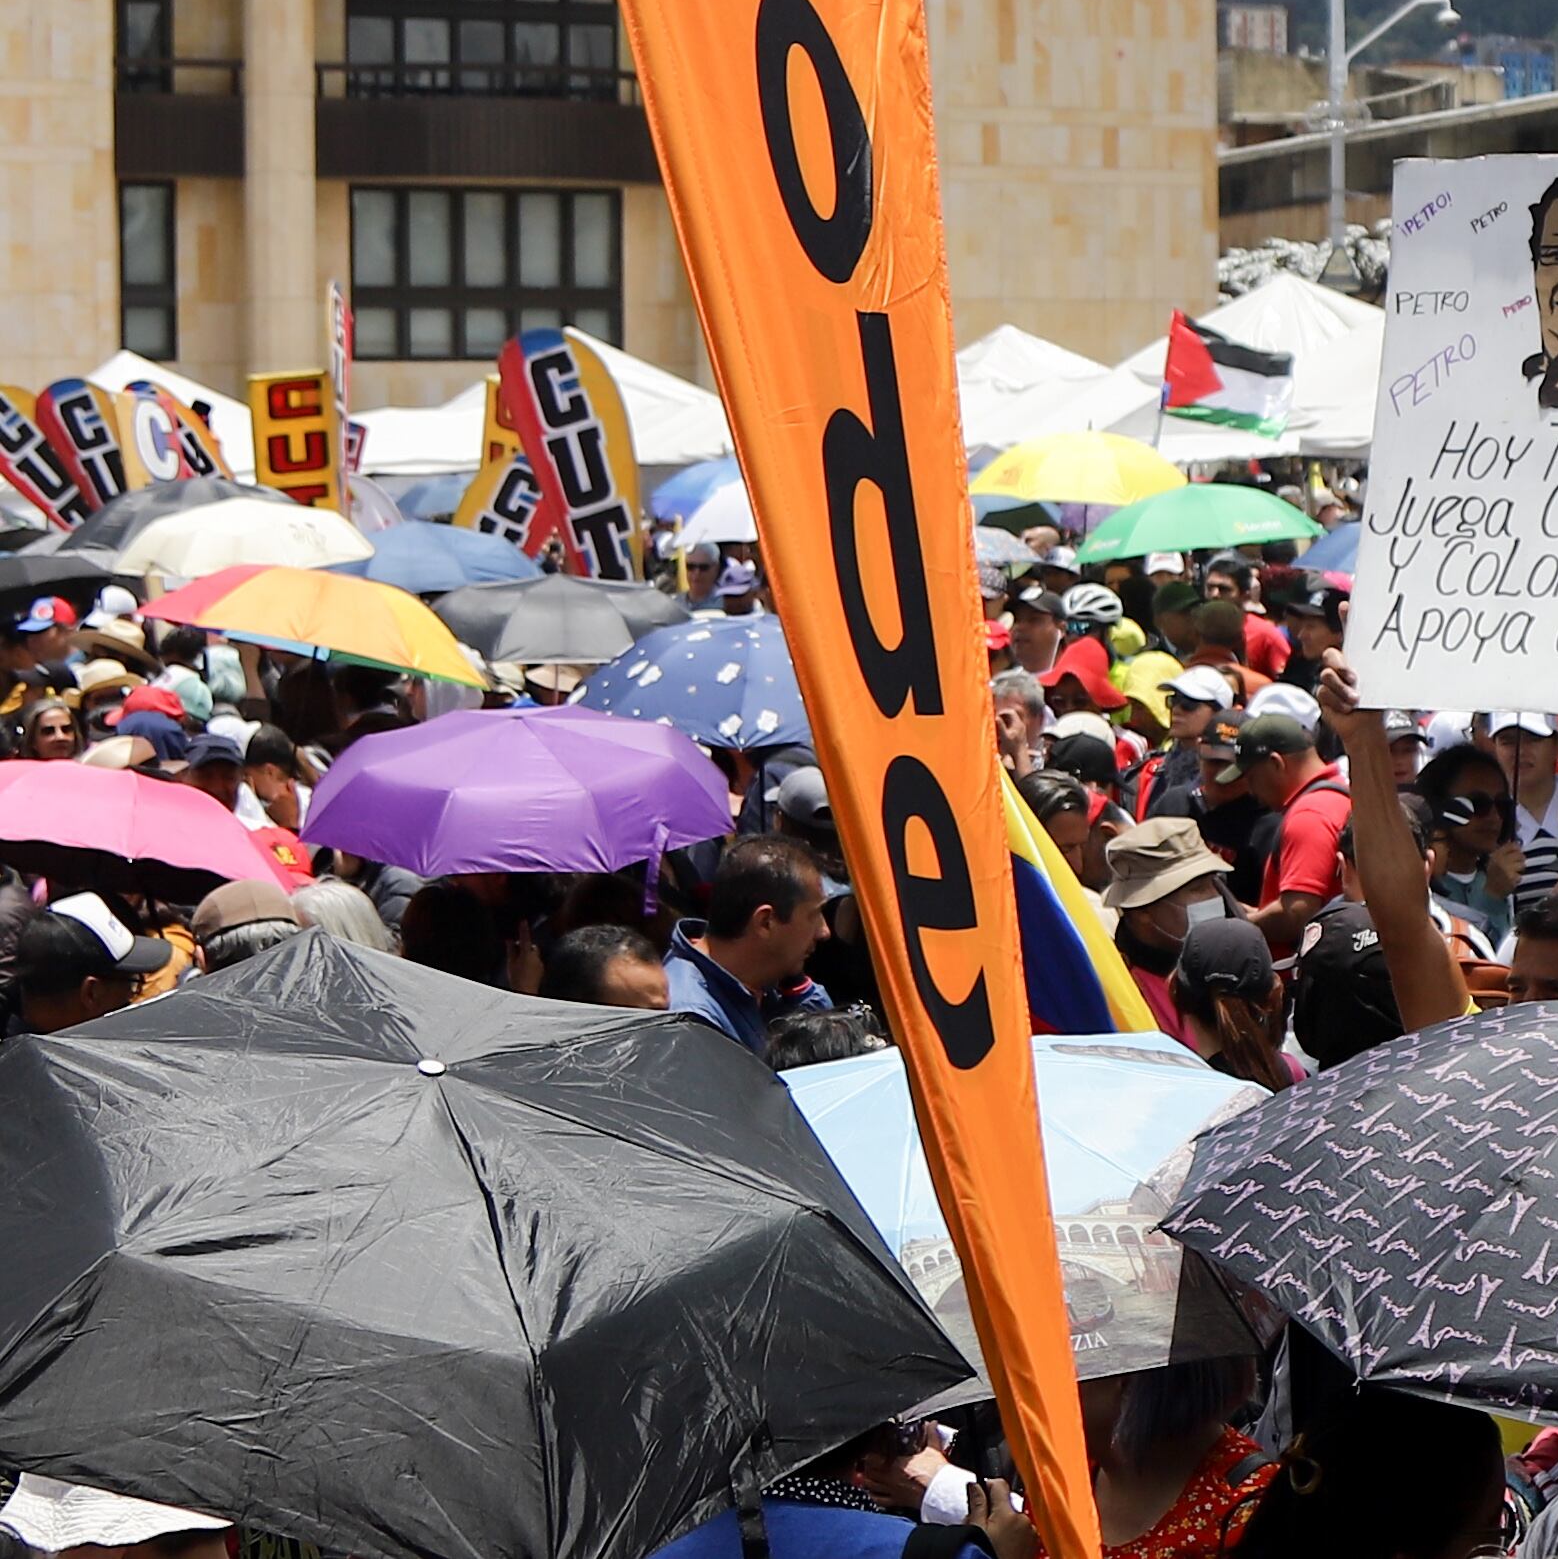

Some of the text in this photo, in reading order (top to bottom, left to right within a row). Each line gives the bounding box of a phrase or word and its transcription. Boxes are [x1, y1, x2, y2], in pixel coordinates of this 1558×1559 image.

[1396, 191, 1453, 239] ¡PETRO!
[1470, 200, 1509, 235] PETRO
[1396, 290, 1469, 315] PETRO
[1388, 333, 1477, 417] PETRO
[530, 348, 631, 580] CUT
[1368, 476, 1516, 542] Juega
